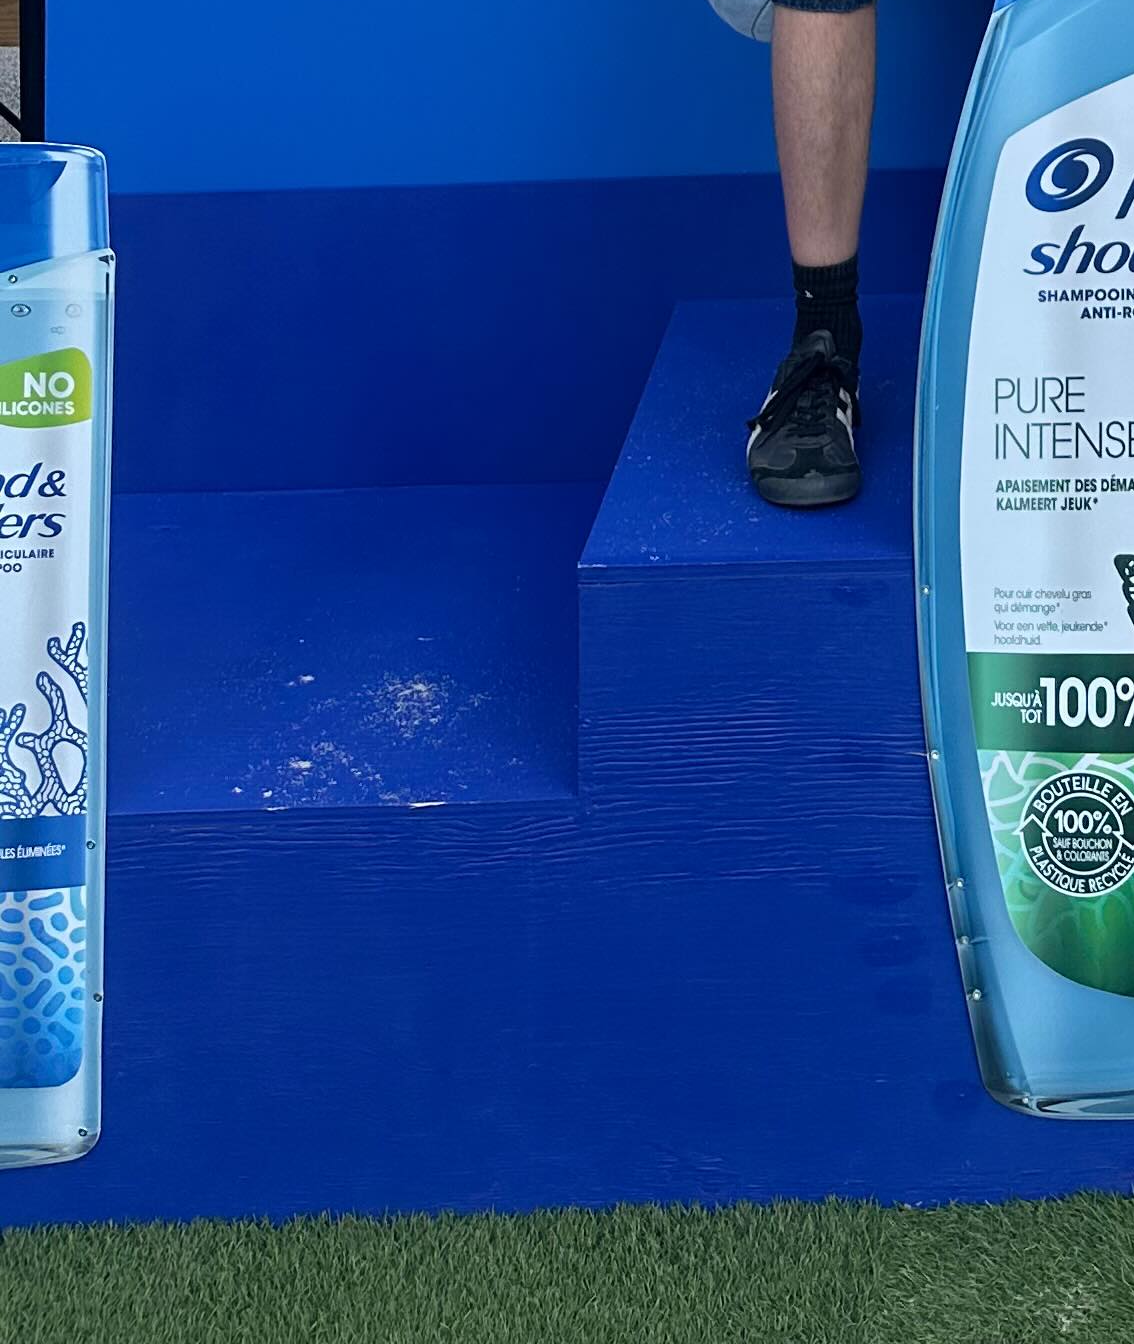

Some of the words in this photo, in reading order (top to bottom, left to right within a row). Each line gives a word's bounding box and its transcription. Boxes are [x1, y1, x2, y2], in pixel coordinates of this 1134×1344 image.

[23, 372, 75, 398] NO
[994, 376, 1085, 414] PURE
[0, 401, 75, 416] LICONES
[38, 470, 67, 498] &
[996, 479, 1071, 493] APAISEMENT
[1075, 478, 1098, 493] DES
[996, 497, 1057, 511] KALMEERT
[0, 549, 55, 560] ICULAIRE
[993, 587, 1014, 599] Pour
[1034, 588, 1071, 599] chevelu
[993, 602, 1009, 614] qui
[994, 620, 1015, 631] Voor
[991, 690, 1043, 708] JUSQU'À
[1021, 709, 1043, 725] TOT
[1032, 776, 1114, 813] BOUTEILLE
[1110, 792, 1133, 816] EN
[1054, 810, 1113, 835] 100%
[1072, 837, 1113, 850] BOUCHON
[1029, 846, 1087, 892] PLASTIQUE
